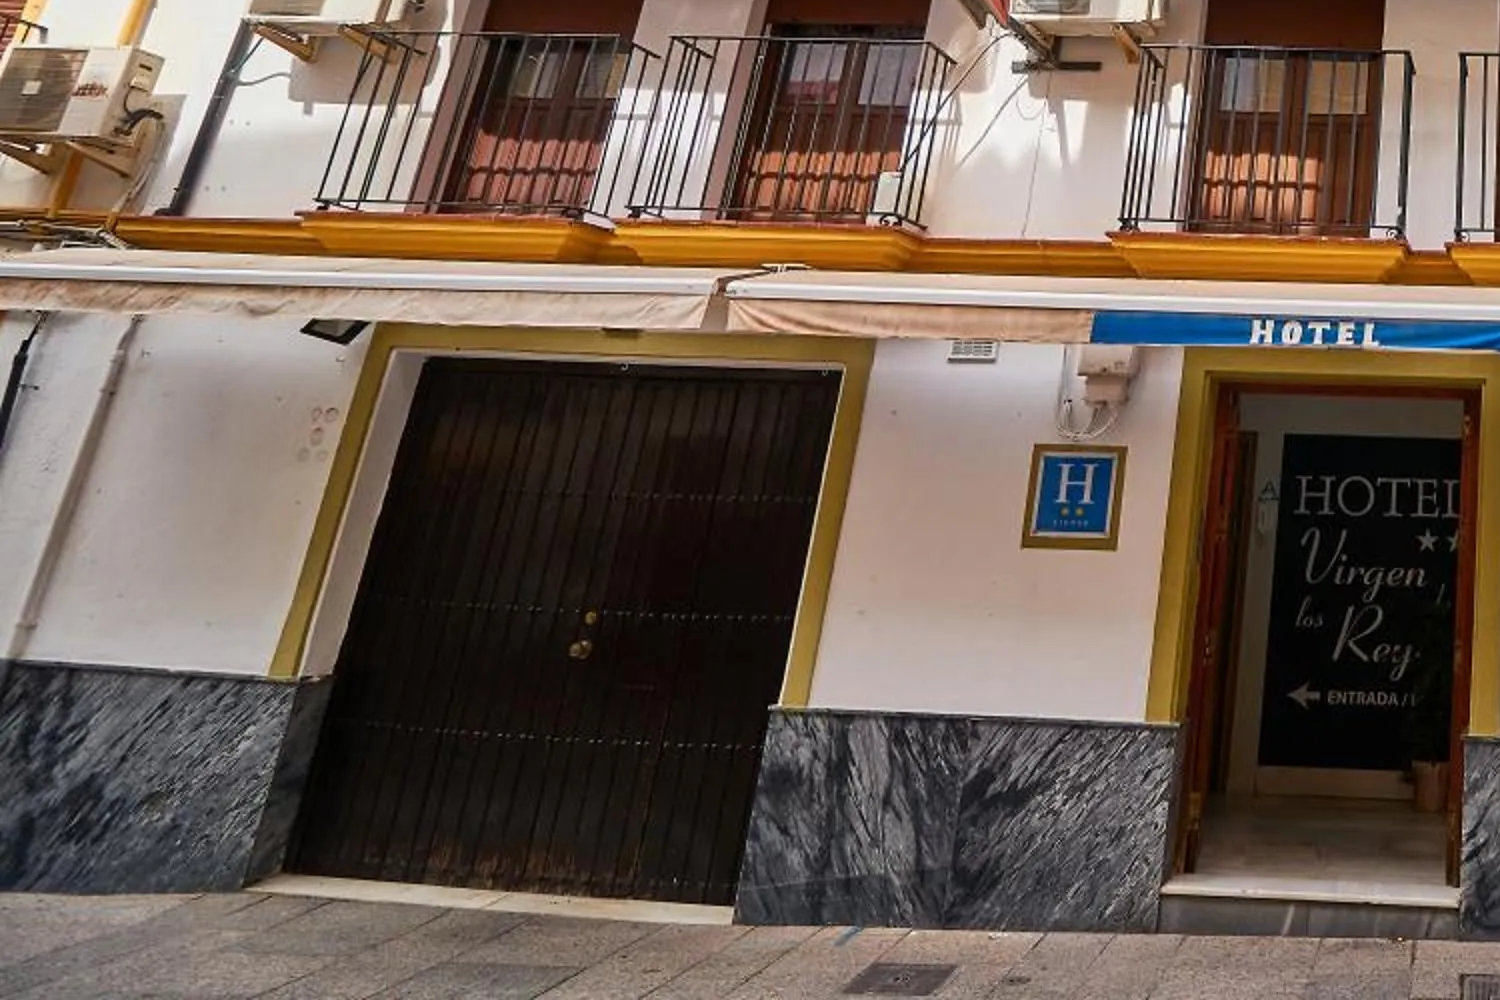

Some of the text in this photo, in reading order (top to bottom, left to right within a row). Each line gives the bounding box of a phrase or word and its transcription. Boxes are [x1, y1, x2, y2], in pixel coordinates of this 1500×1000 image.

[1249, 318, 1381, 347] HOTEL
[1056, 463, 1099, 505] H
[1301, 526, 1428, 601] Virgen
[1295, 596, 1421, 681] los Rey
[1327, 689, 1399, 708] ENTRADA
